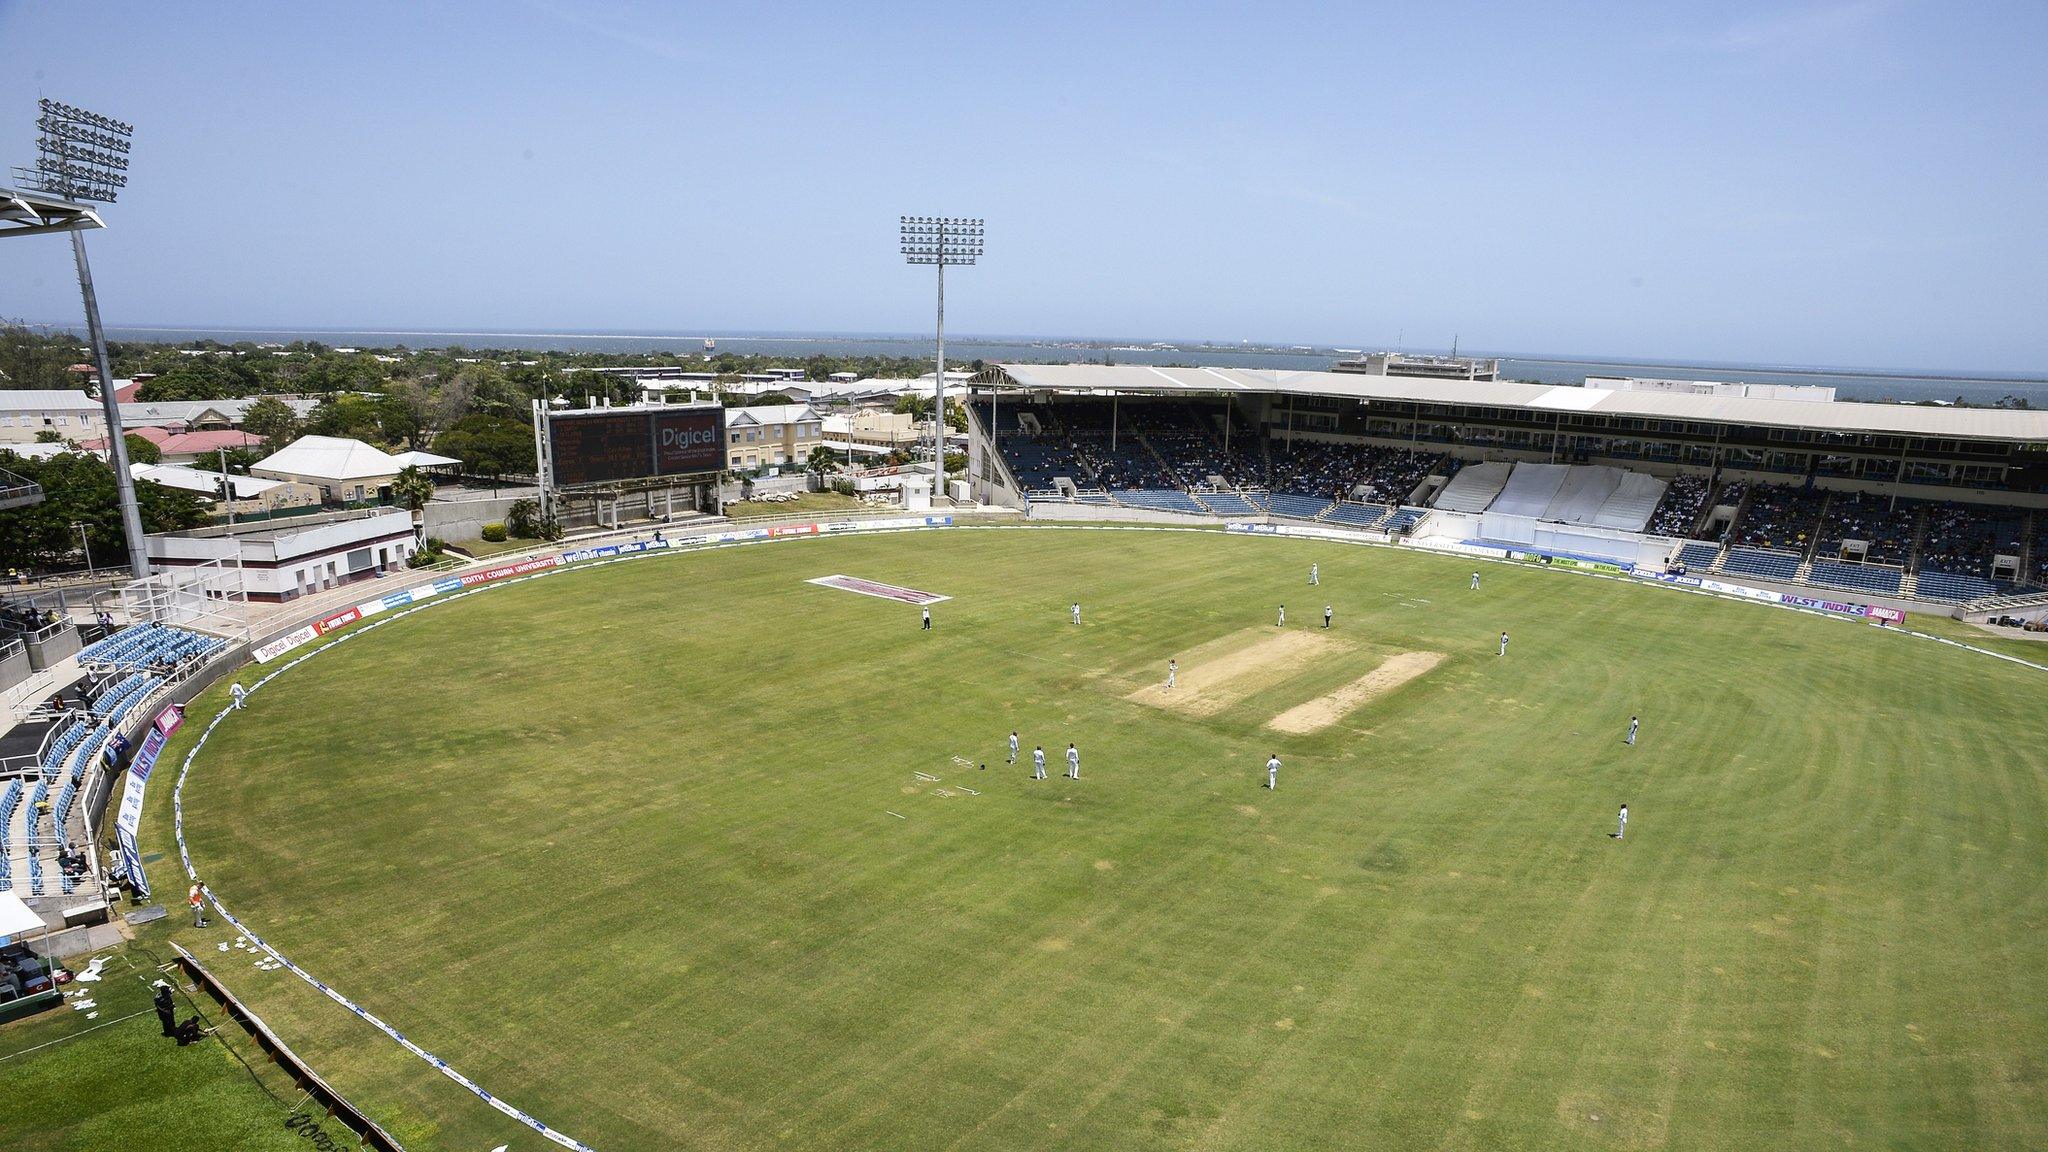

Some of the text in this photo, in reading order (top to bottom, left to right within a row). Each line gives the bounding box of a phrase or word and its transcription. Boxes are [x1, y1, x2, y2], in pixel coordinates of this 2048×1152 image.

[662, 425, 716, 450] Digicel
[462, 574, 484, 585] EDITH
[486, 567, 514, 580] COWAN
[516, 557, 555, 573] UNIVERSITY
[261, 628, 312, 657] Digicel Digicel
